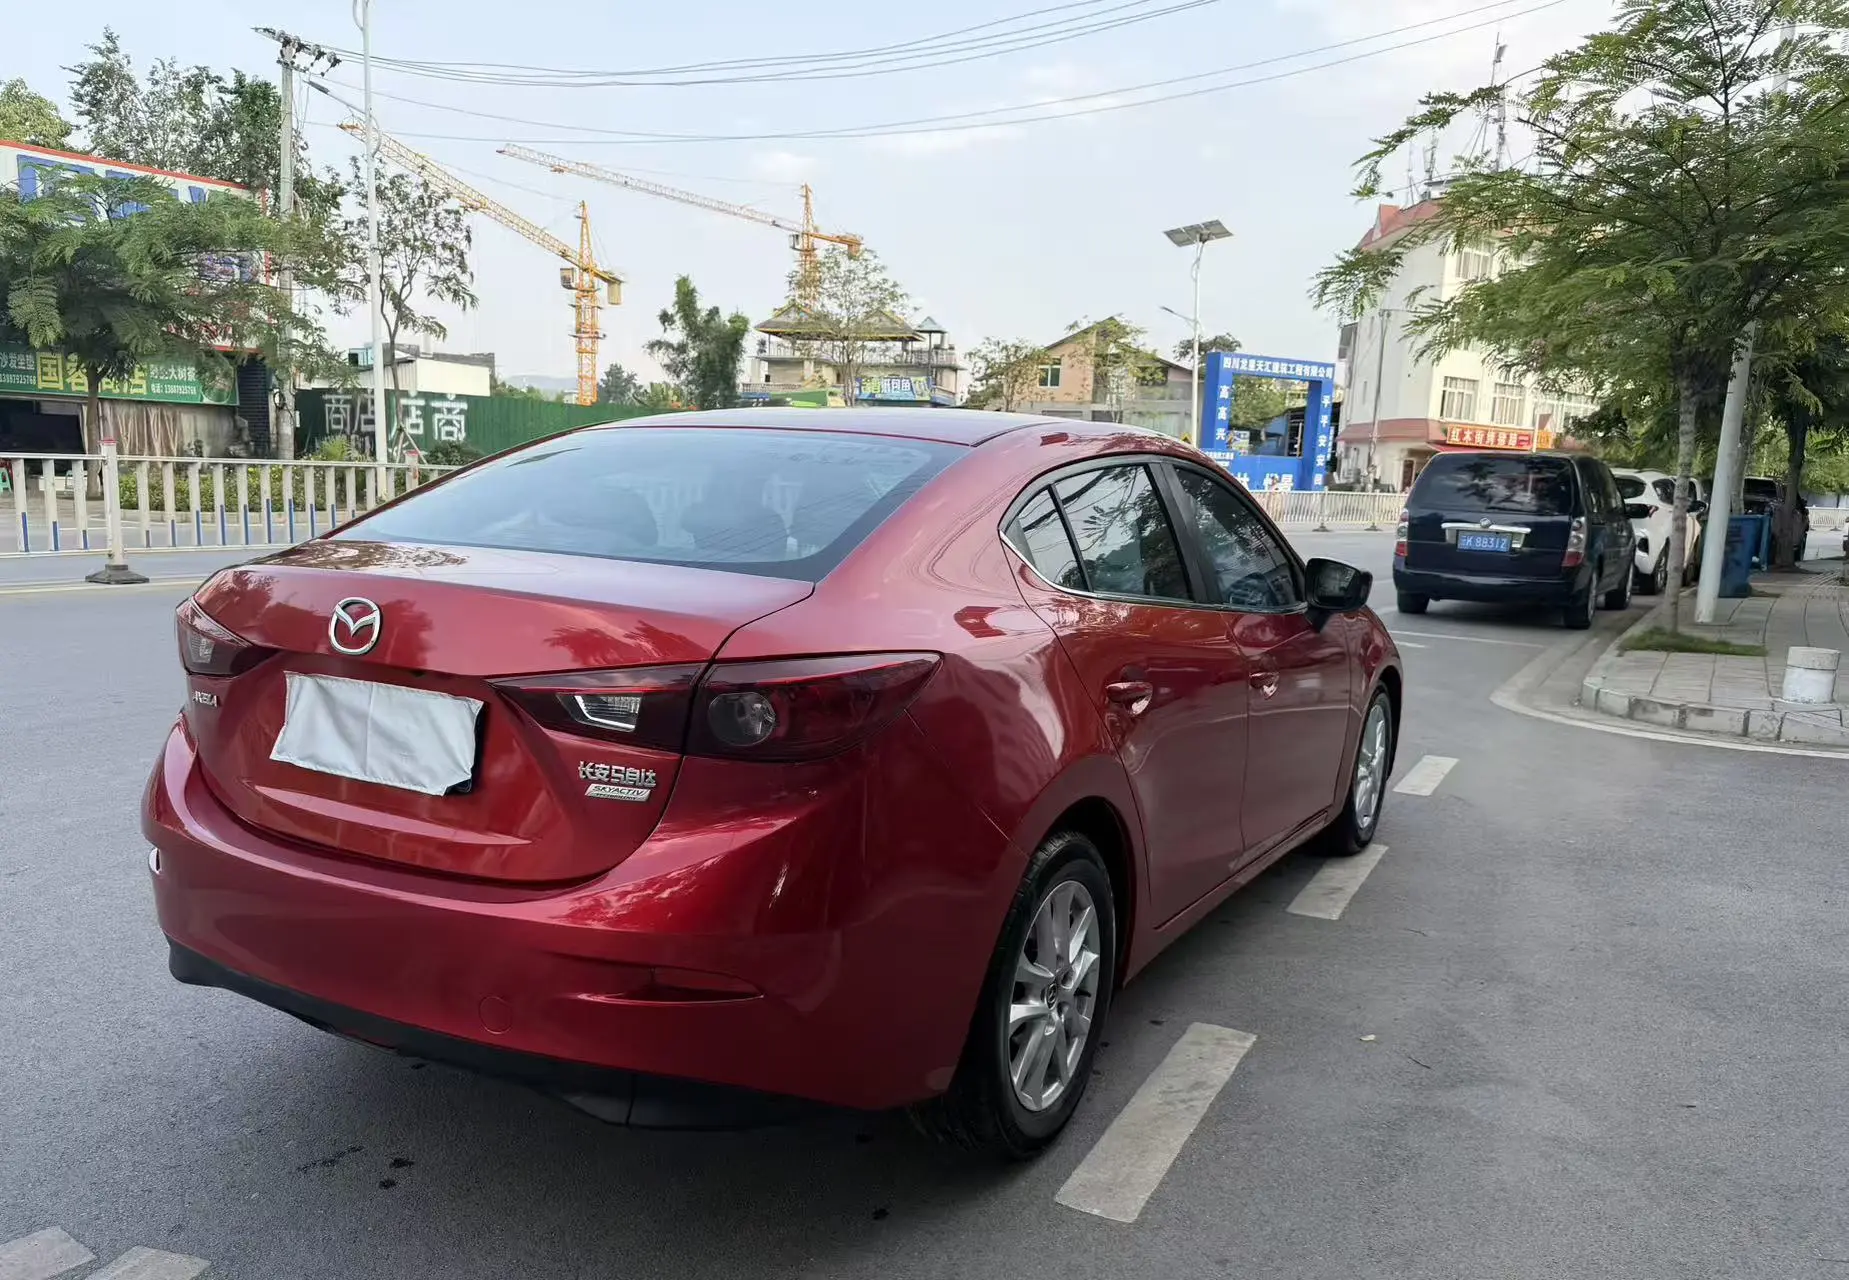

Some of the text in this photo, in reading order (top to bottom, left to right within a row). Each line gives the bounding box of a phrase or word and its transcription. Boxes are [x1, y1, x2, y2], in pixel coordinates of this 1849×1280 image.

[578, 761, 656, 787] 长安马自达
[592, 784, 645, 796] SKYACTIV
